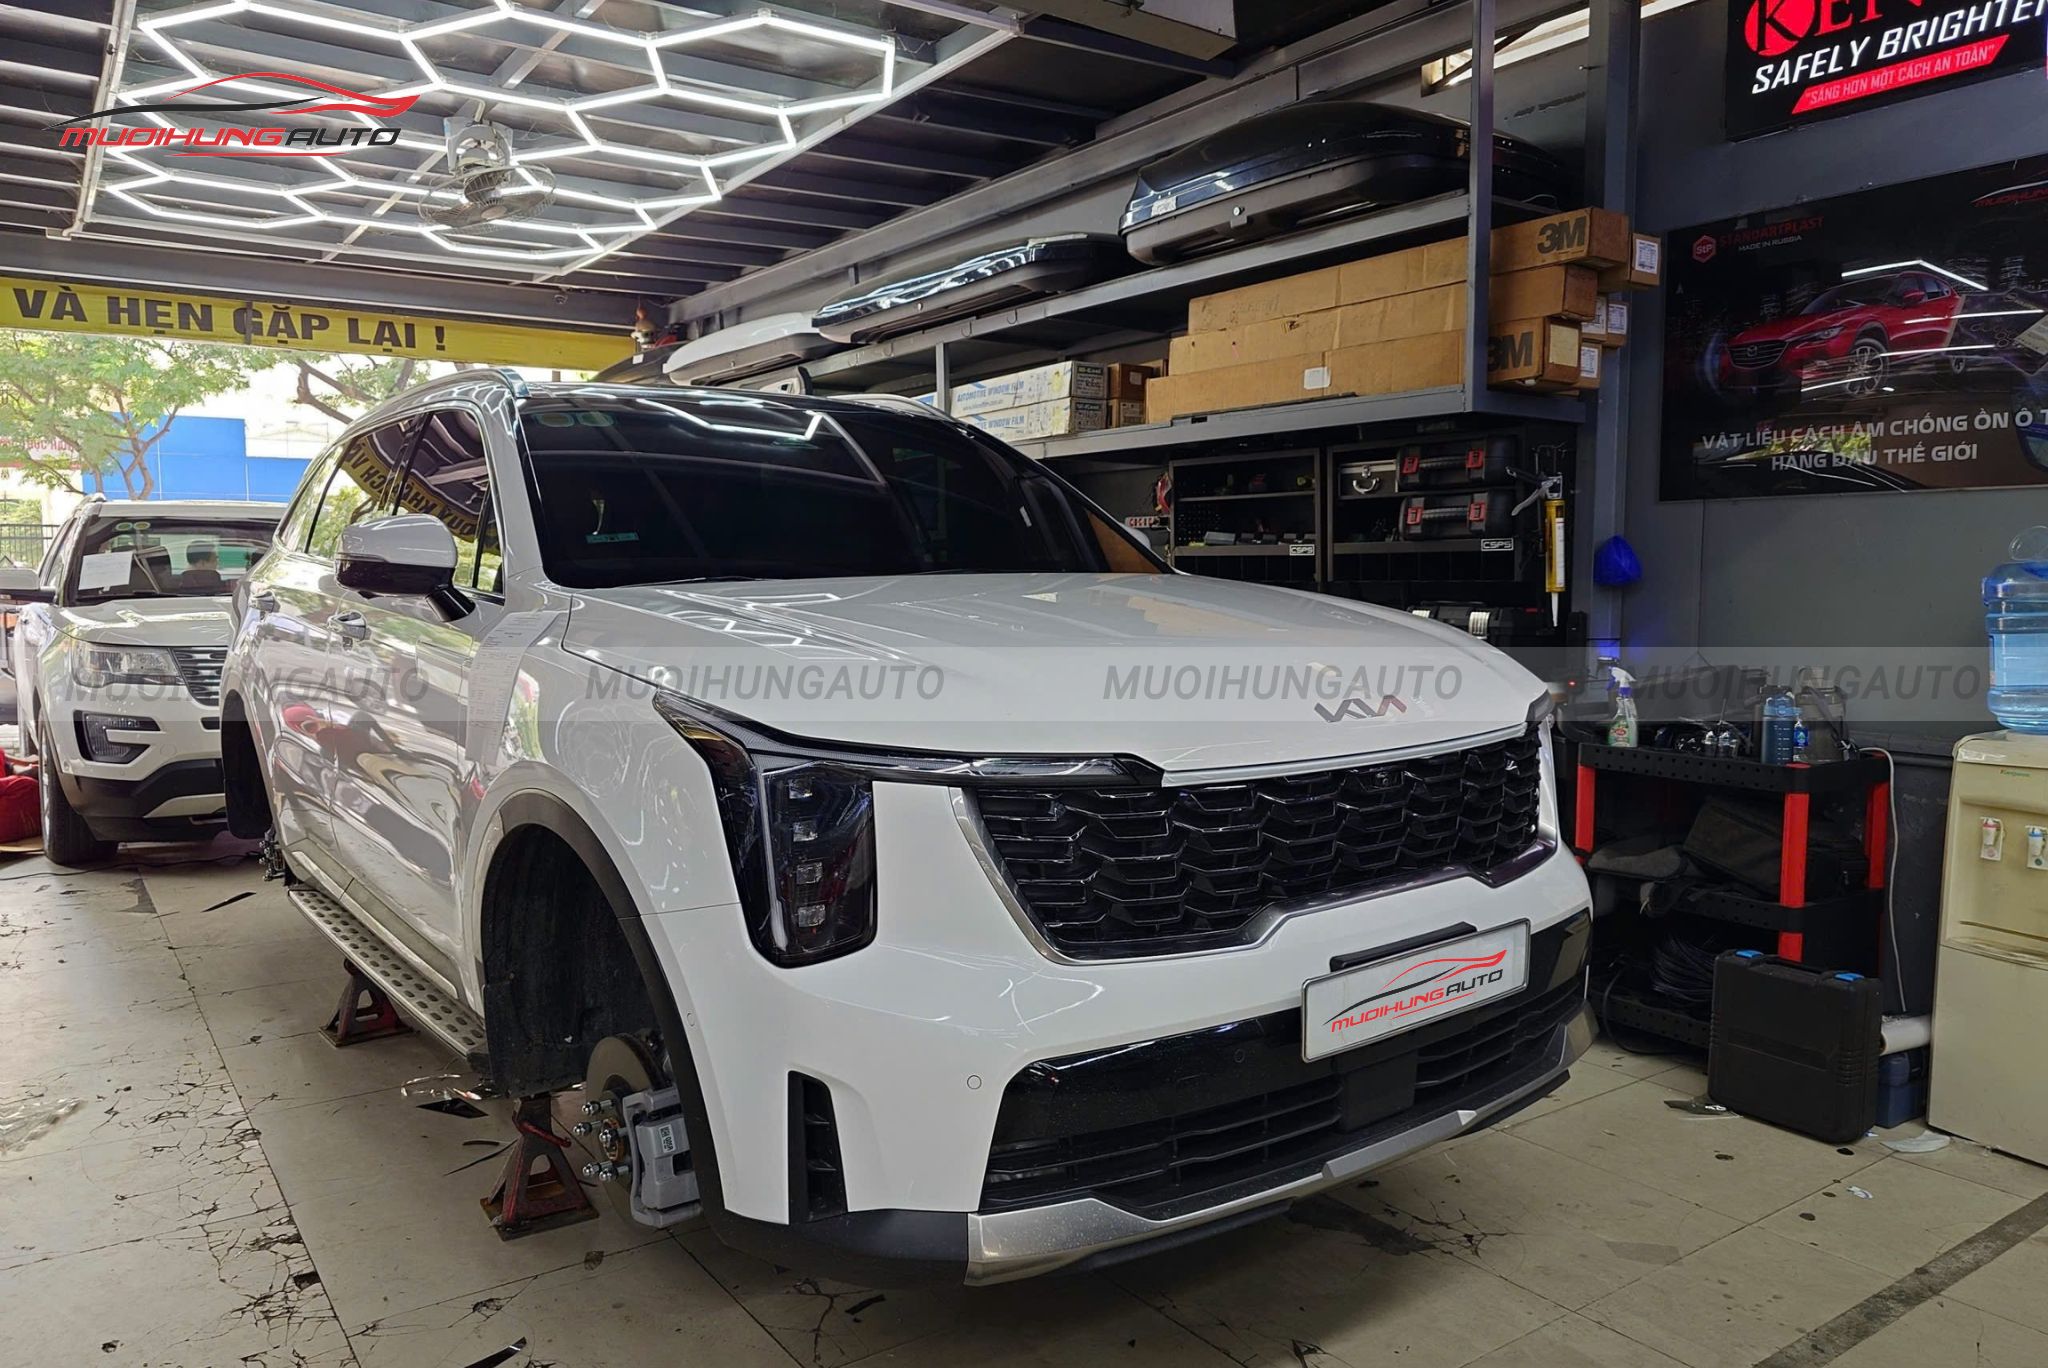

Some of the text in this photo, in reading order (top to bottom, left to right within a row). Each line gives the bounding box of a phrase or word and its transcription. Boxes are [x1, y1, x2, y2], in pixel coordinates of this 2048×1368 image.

[1751, 36, 1871, 95] SAFELY
[1843, 78, 1870, 95] HƠN
[1898, 62, 1931, 81] CÁCH
[1934, 56, 1953, 72] AN
[1536, 215, 1587, 255] 3M
[1738, 235, 1802, 252] MADE IN RUSSIA
[12, 286, 447, 353] VÀ HẸN GẶP LẠI !
[1488, 331, 1534, 373] 3M
[1011, 415, 1025, 426] FILM
[1851, 420, 1885, 438] ÂM
[1890, 411, 1968, 436] CHỐNG
[1973, 407, 2009, 430] ỒN
[2014, 407, 2034, 428] Ô
[1883, 442, 1926, 465] THẾ
[1932, 440, 1979, 463] GIỚI
[1290, 546, 1314, 555] CSPS
[1482, 540, 1512, 550] CSPS
